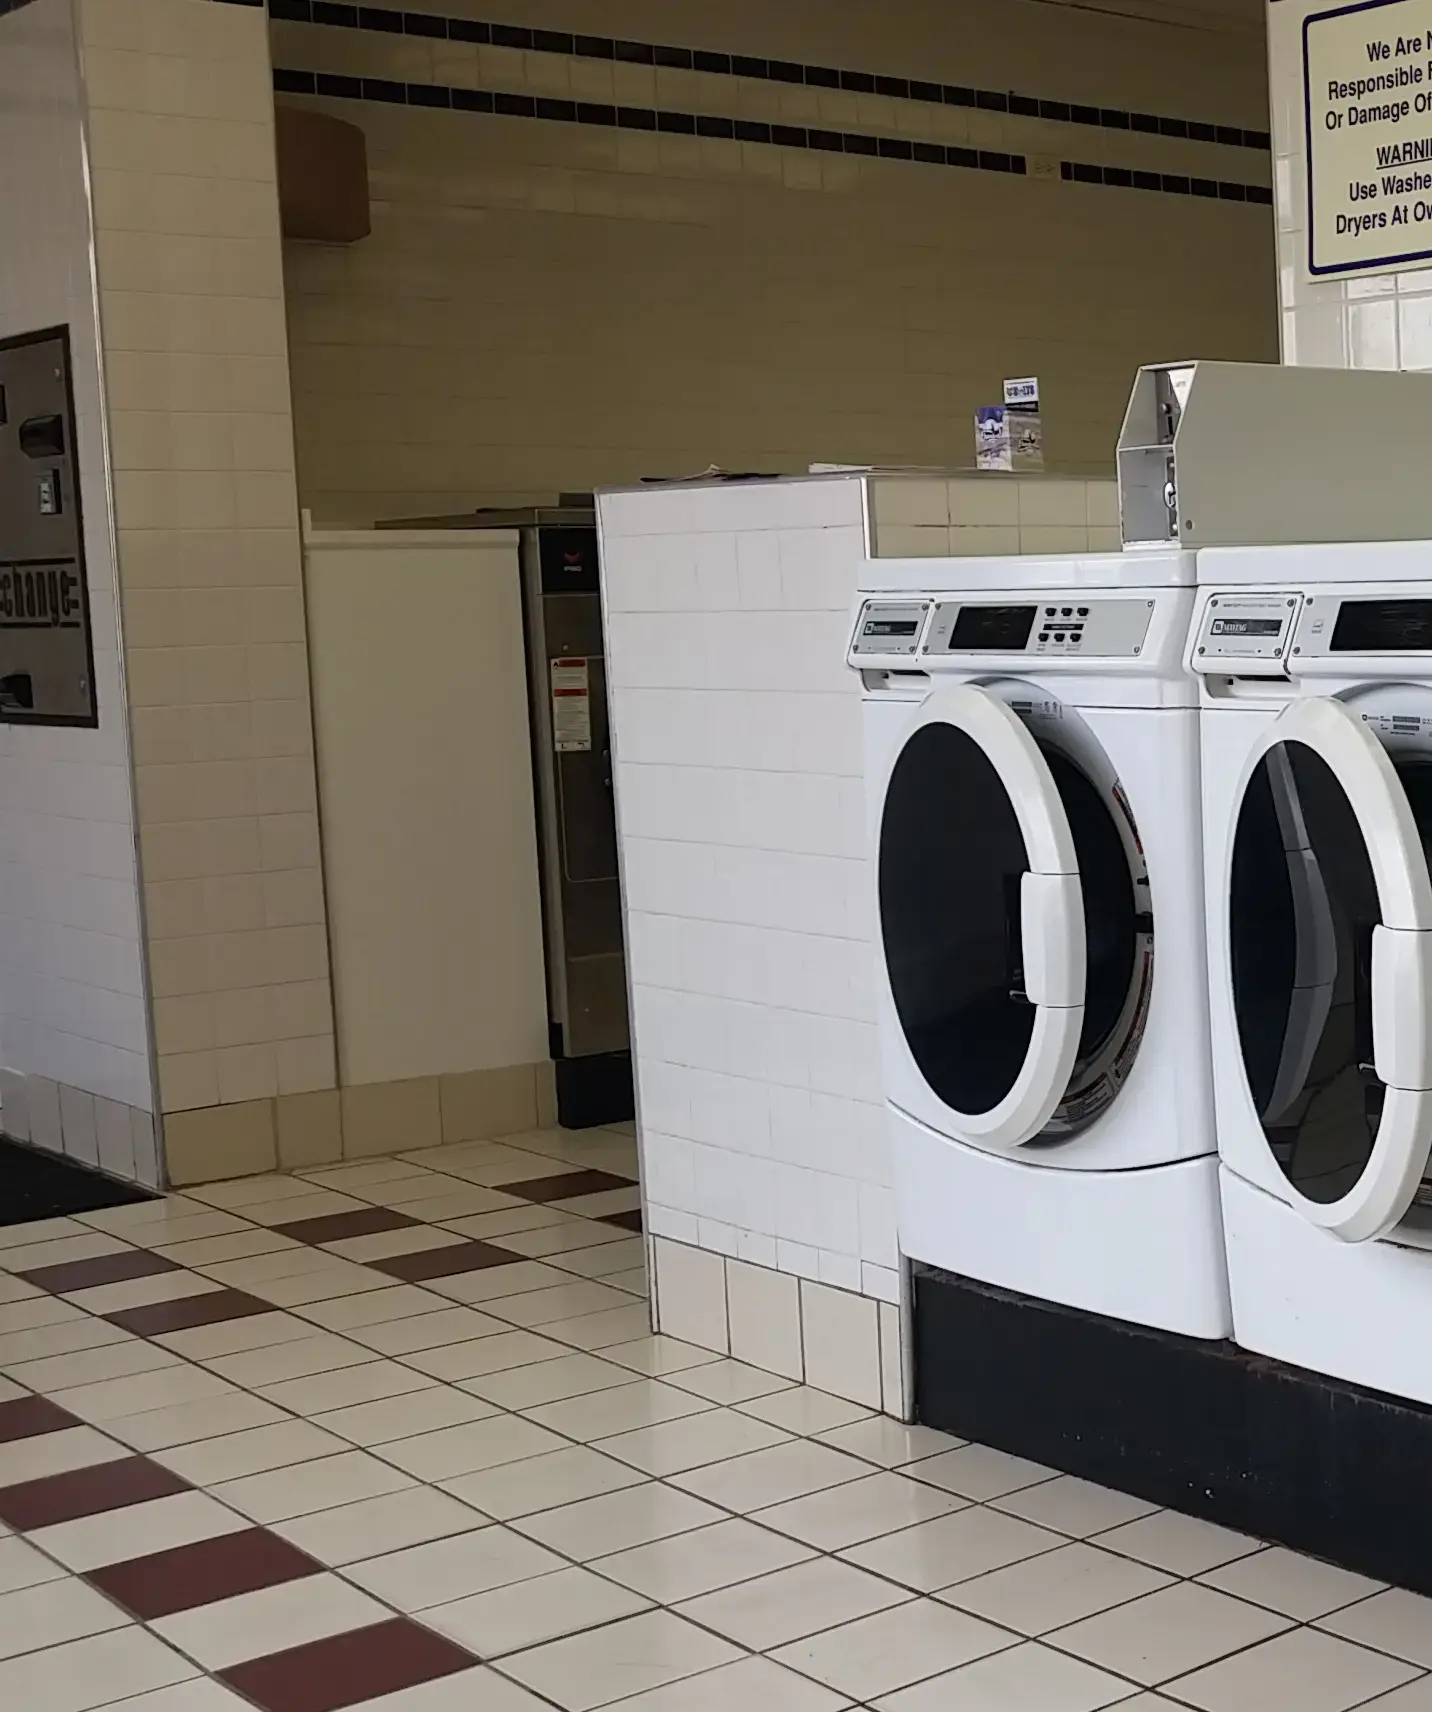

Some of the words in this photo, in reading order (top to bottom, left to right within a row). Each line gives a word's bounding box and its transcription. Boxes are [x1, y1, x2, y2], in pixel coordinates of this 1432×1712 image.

[1366, 41, 1390, 62] We
[1395, 37, 1421, 56] Are
[1328, 65, 1423, 100] Responsible
[1325, 111, 1343, 130] Or
[1348, 100, 1409, 126] Damage
[1414, 92, 1432, 113] Of
[1350, 182, 1377, 201] Use
[1336, 211, 1387, 237] Dryers
[1391, 205, 1408, 225] At
[2, 563, 71, 626] change
